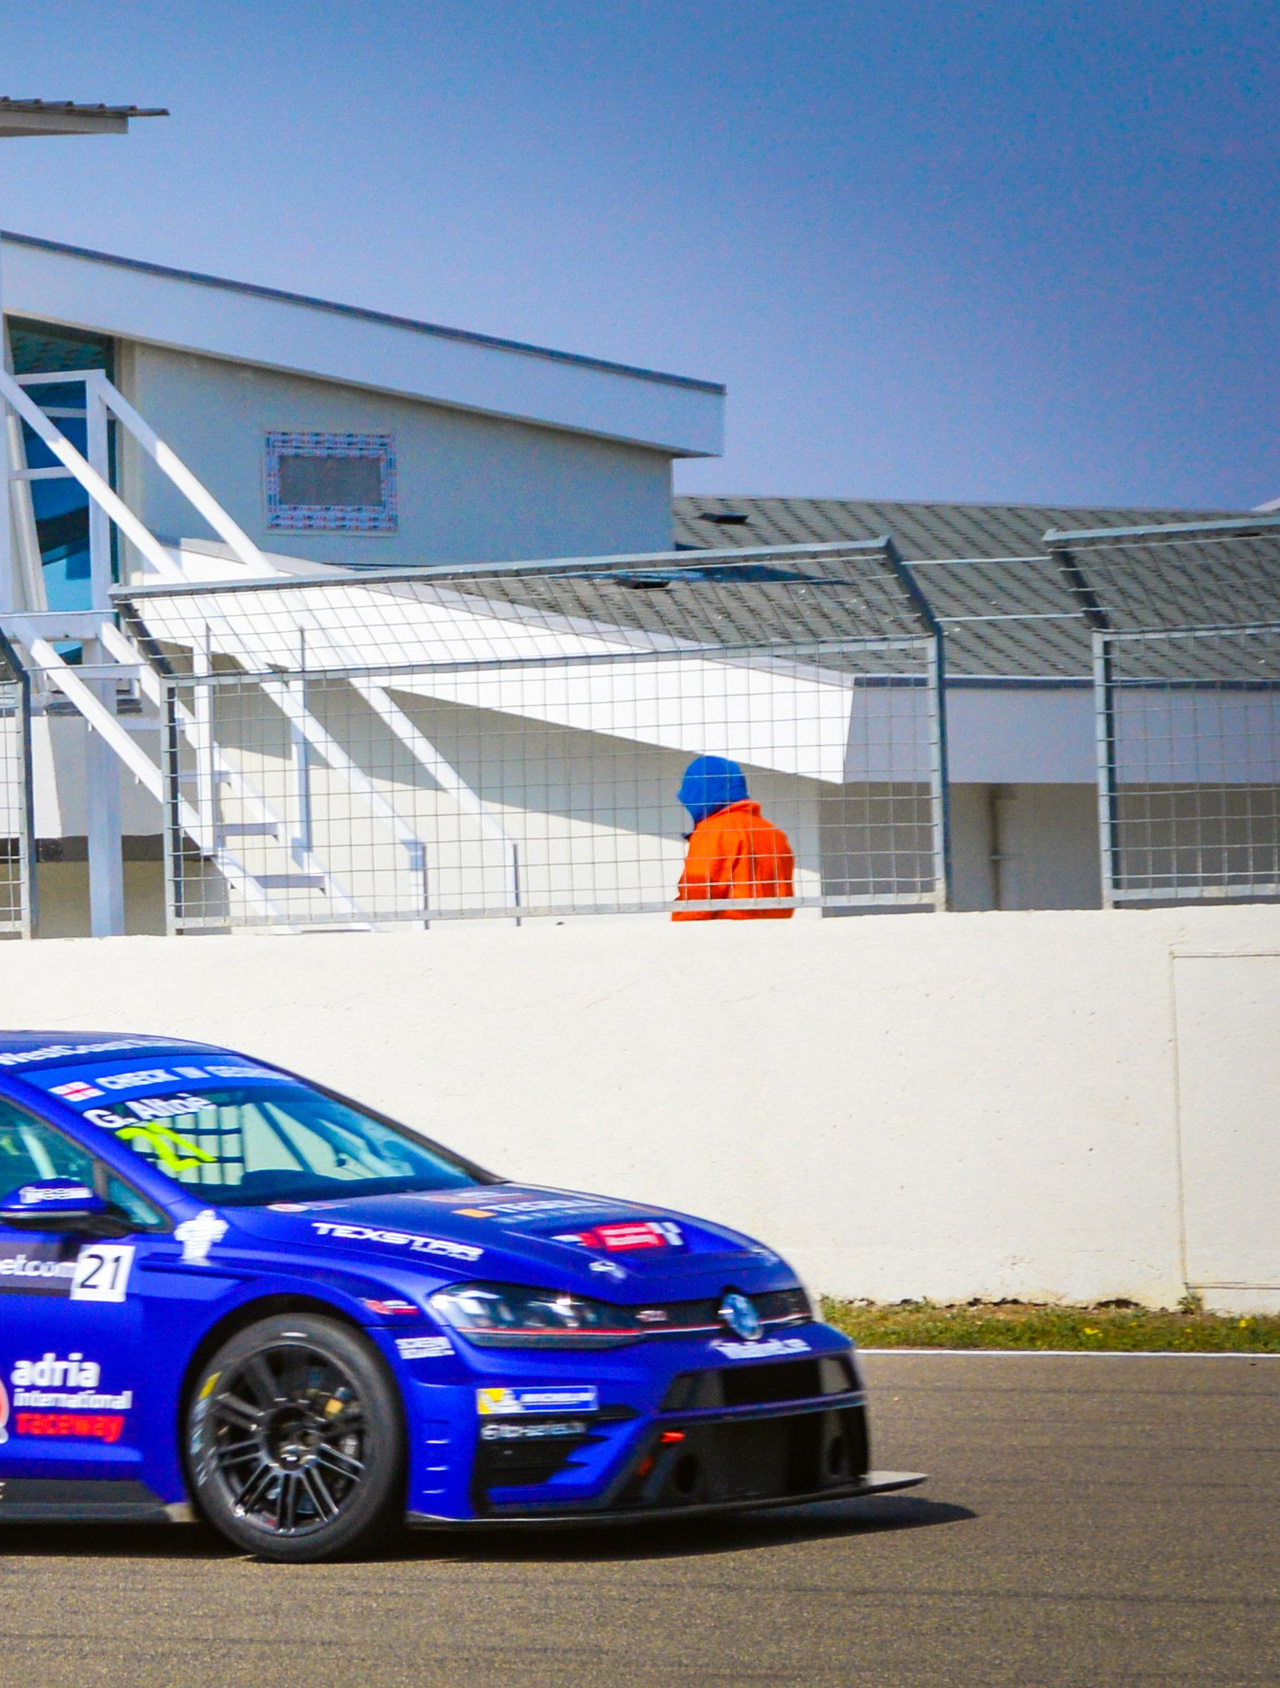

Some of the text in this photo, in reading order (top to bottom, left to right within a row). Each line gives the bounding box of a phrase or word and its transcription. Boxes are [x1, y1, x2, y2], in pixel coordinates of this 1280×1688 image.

[311, 1222, 484, 1262] TEXSTAR
[80, 1253, 122, 1291] 21
[10, 1352, 100, 1387] adria
[15, 1413, 124, 1442] raceway
